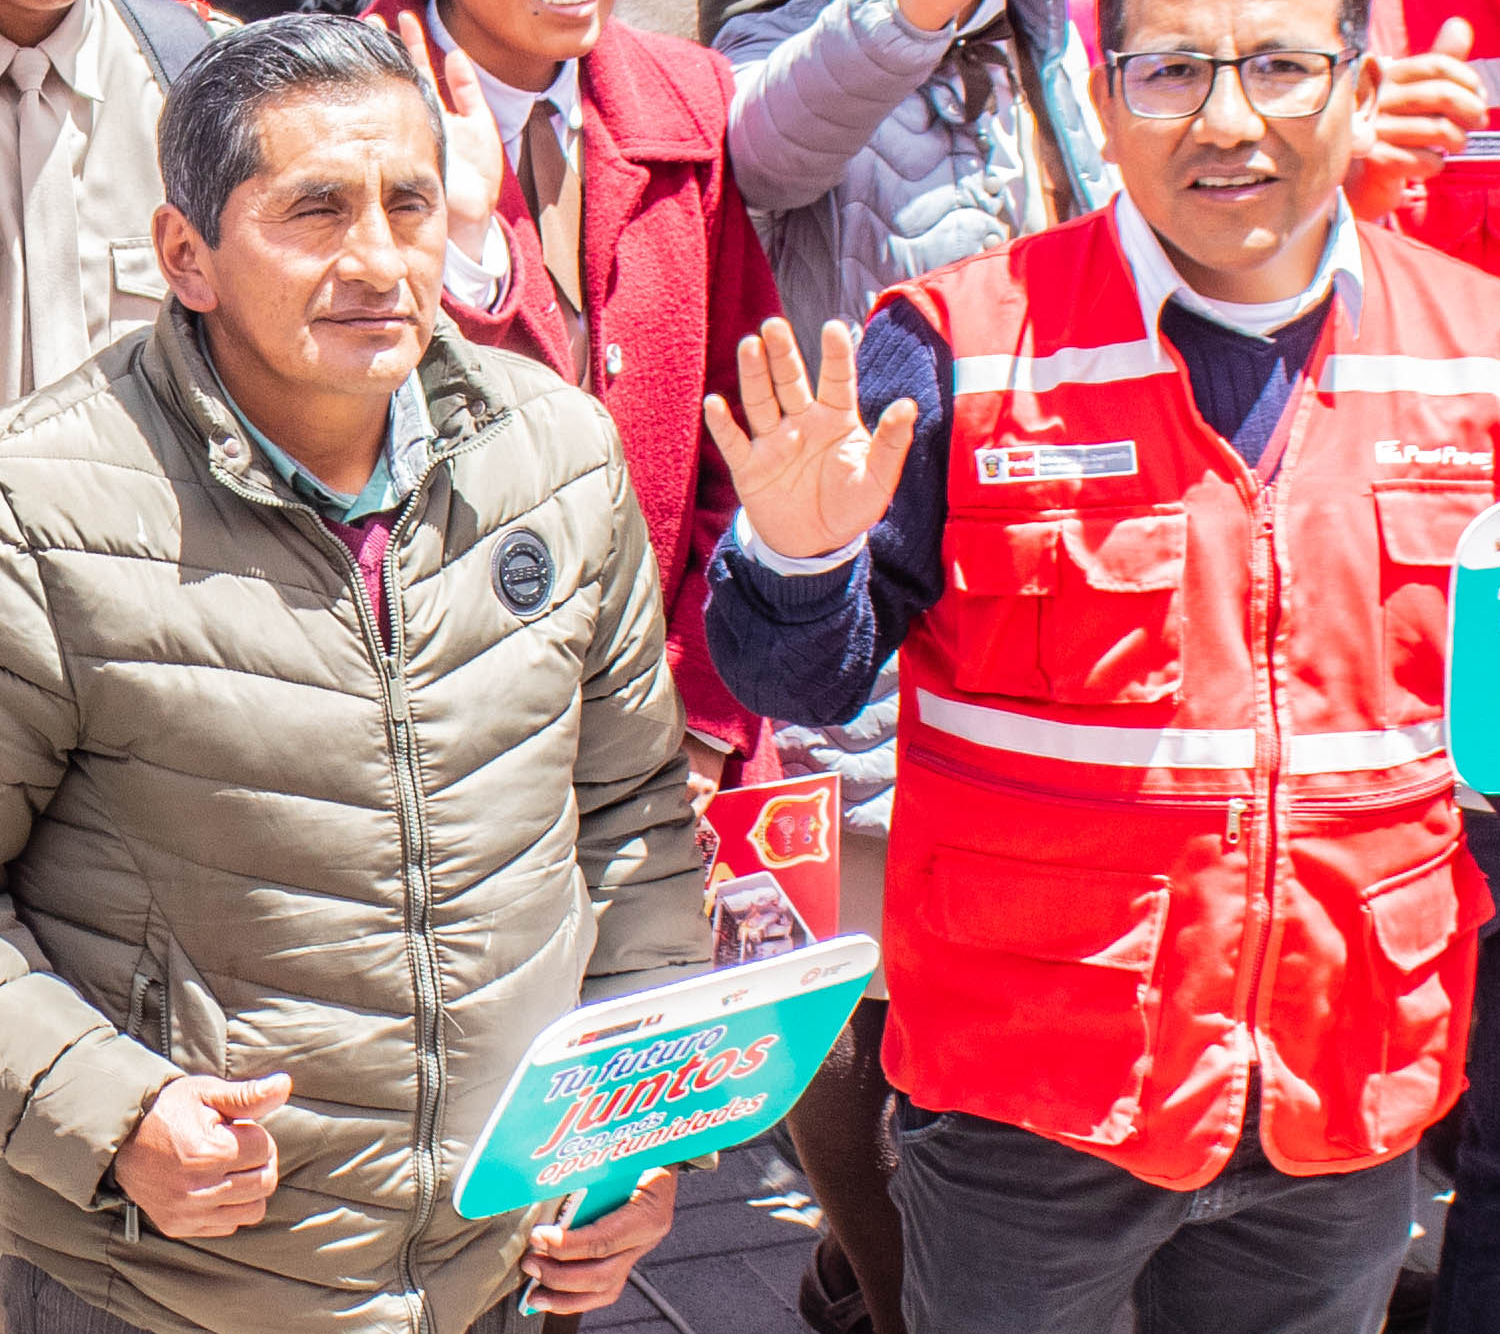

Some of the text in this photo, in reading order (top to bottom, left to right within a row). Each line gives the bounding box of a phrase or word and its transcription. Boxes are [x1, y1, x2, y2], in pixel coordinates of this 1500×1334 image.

[531, 1033, 779, 1160] juntos
[544, 1065, 595, 1103] Tu
[600, 1024, 727, 1087] futuro
[536, 1092, 768, 1186] oportunidades
[556, 1109, 663, 1160] Con más
